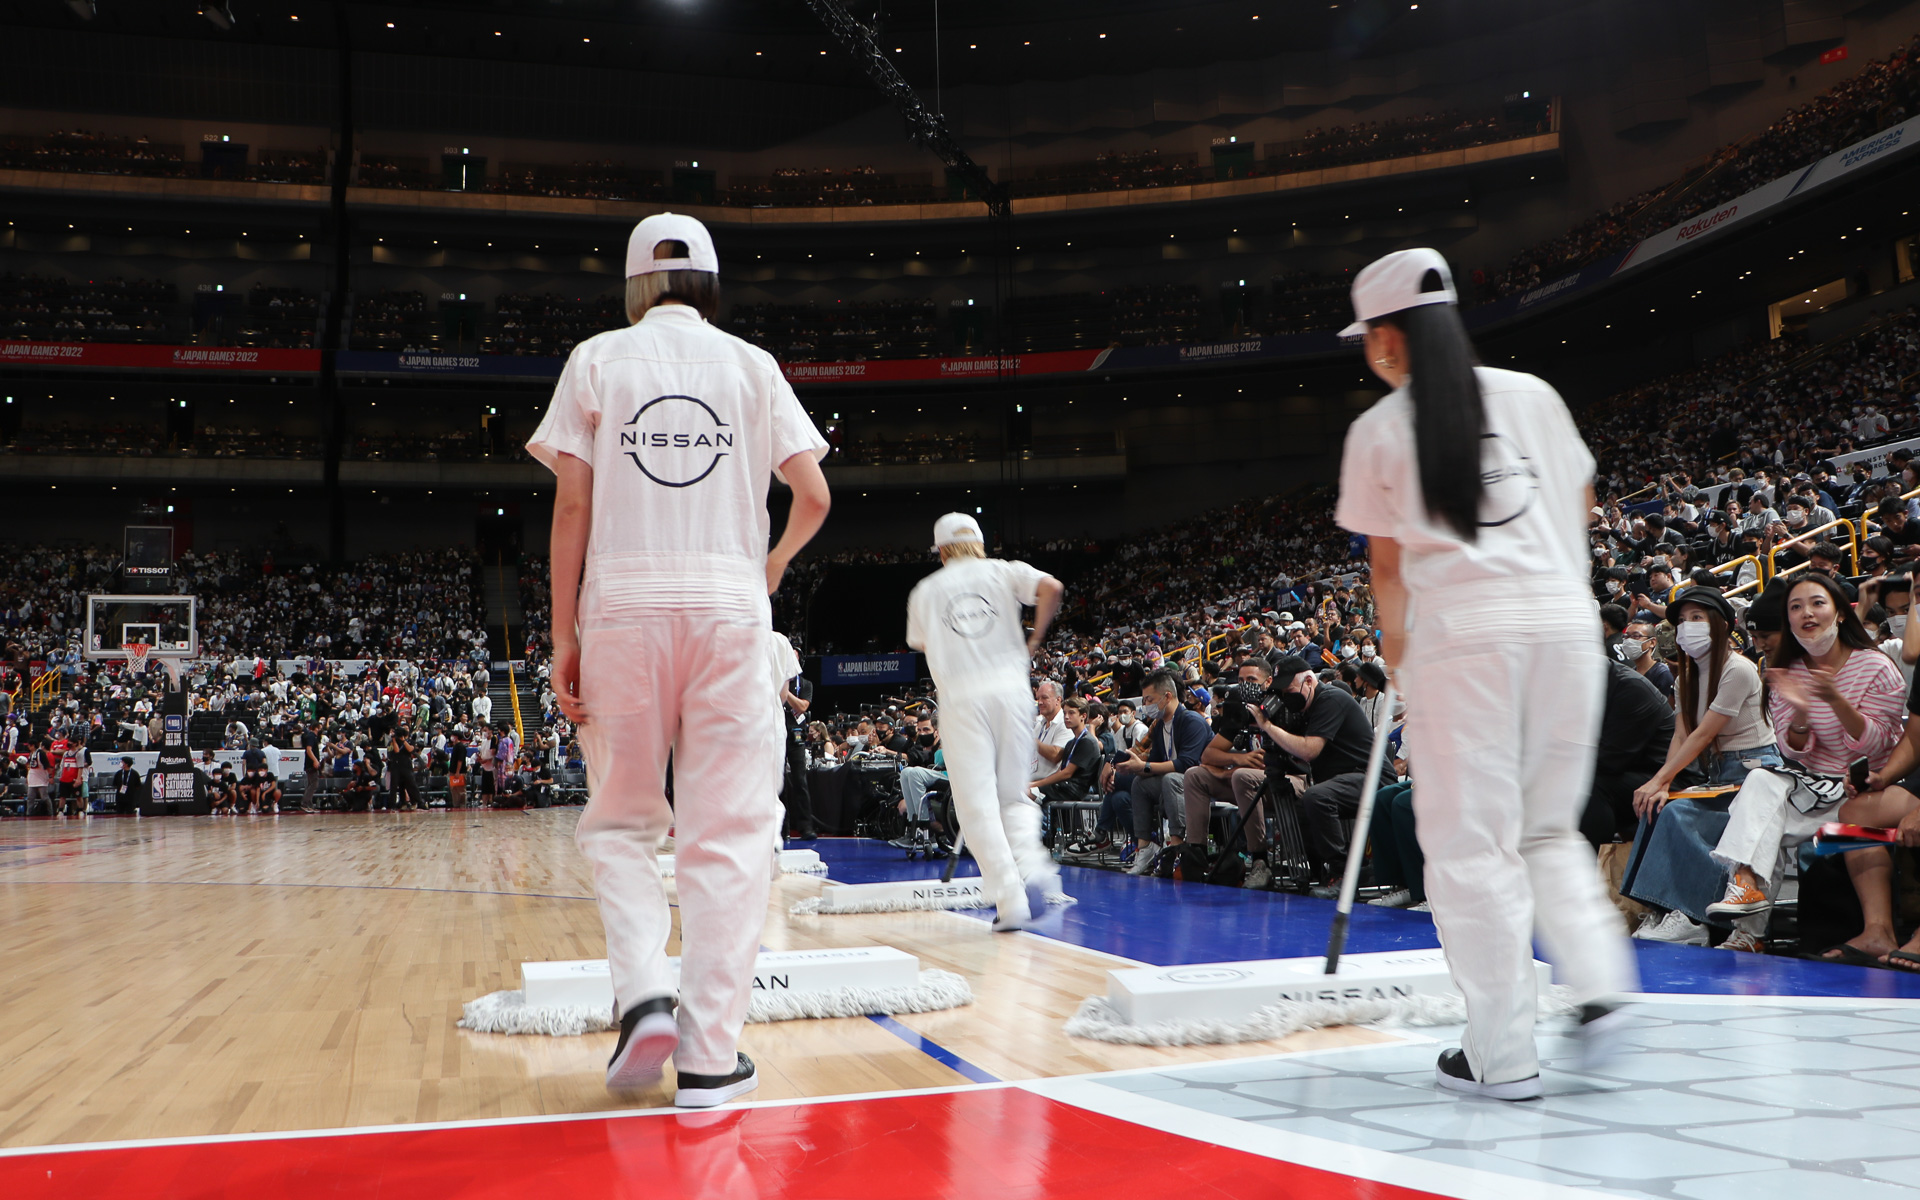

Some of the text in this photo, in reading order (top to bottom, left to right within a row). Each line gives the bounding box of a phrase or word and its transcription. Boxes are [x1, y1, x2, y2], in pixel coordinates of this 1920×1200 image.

[1839, 127, 1904, 163] AMERICAN
[1844, 136, 1901, 167] EXPRESS
[1676, 205, 1738, 241] Rakuten
[2, 344, 31, 355] JAPAN
[31, 345, 60, 357] GAMES
[59, 346, 84, 358] 2022
[1187, 345, 1213, 357] JAPAN
[1213, 342, 1239, 355] GAMES
[1240, 340, 1262, 353] 2022
[181, 350, 259, 362] JAPAN GAMES 2022
[406, 355, 432, 366] JAPAN
[432, 356, 458, 367] GAMES
[458, 357, 480, 368] 2022
[793, 364, 866, 377] JAPAN GAMES 2022
[948, 360, 973, 372] JAPAN
[973, 359, 999, 371] GAMES
[620, 431, 733, 448] NISSAN
[843, 660, 899, 673] JAPAN GAMES 2022
[160, 756, 187, 765] Rakuten
[165, 780, 195, 790] SATURDAY
[165, 789, 181, 799] NIGHT
[180, 789, 194, 798] 2022
[913, 885, 982, 899] NISSAN
